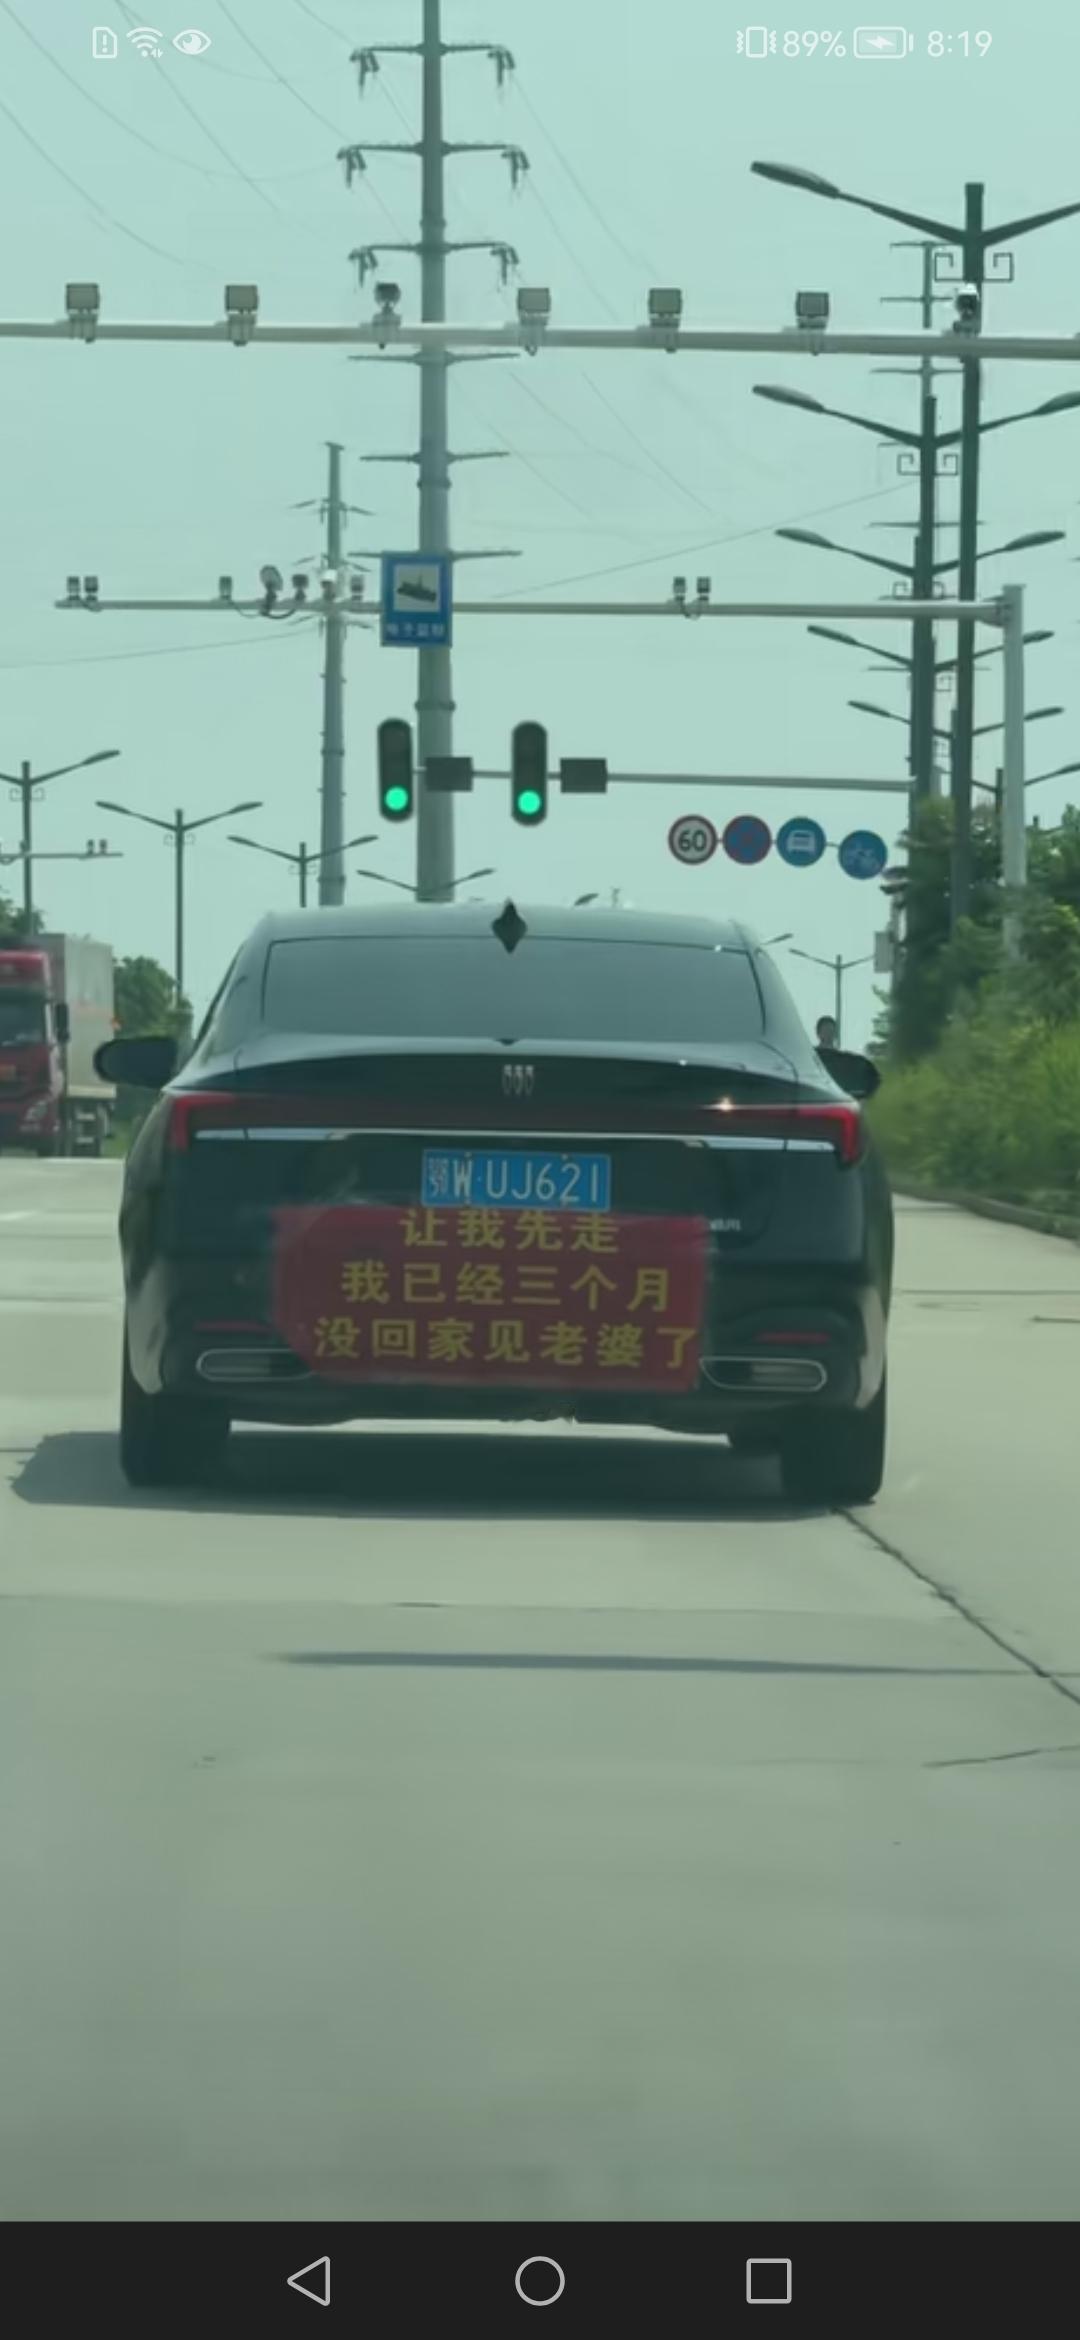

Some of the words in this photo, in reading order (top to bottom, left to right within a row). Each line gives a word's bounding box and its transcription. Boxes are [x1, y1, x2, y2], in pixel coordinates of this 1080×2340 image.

[677, 829, 708, 852] 60
[398, 1207, 621, 1253] 让我先走
[341, 1259, 671, 1312] 我已经三个月
[313, 1316, 697, 1370] 没回家见老婆了
